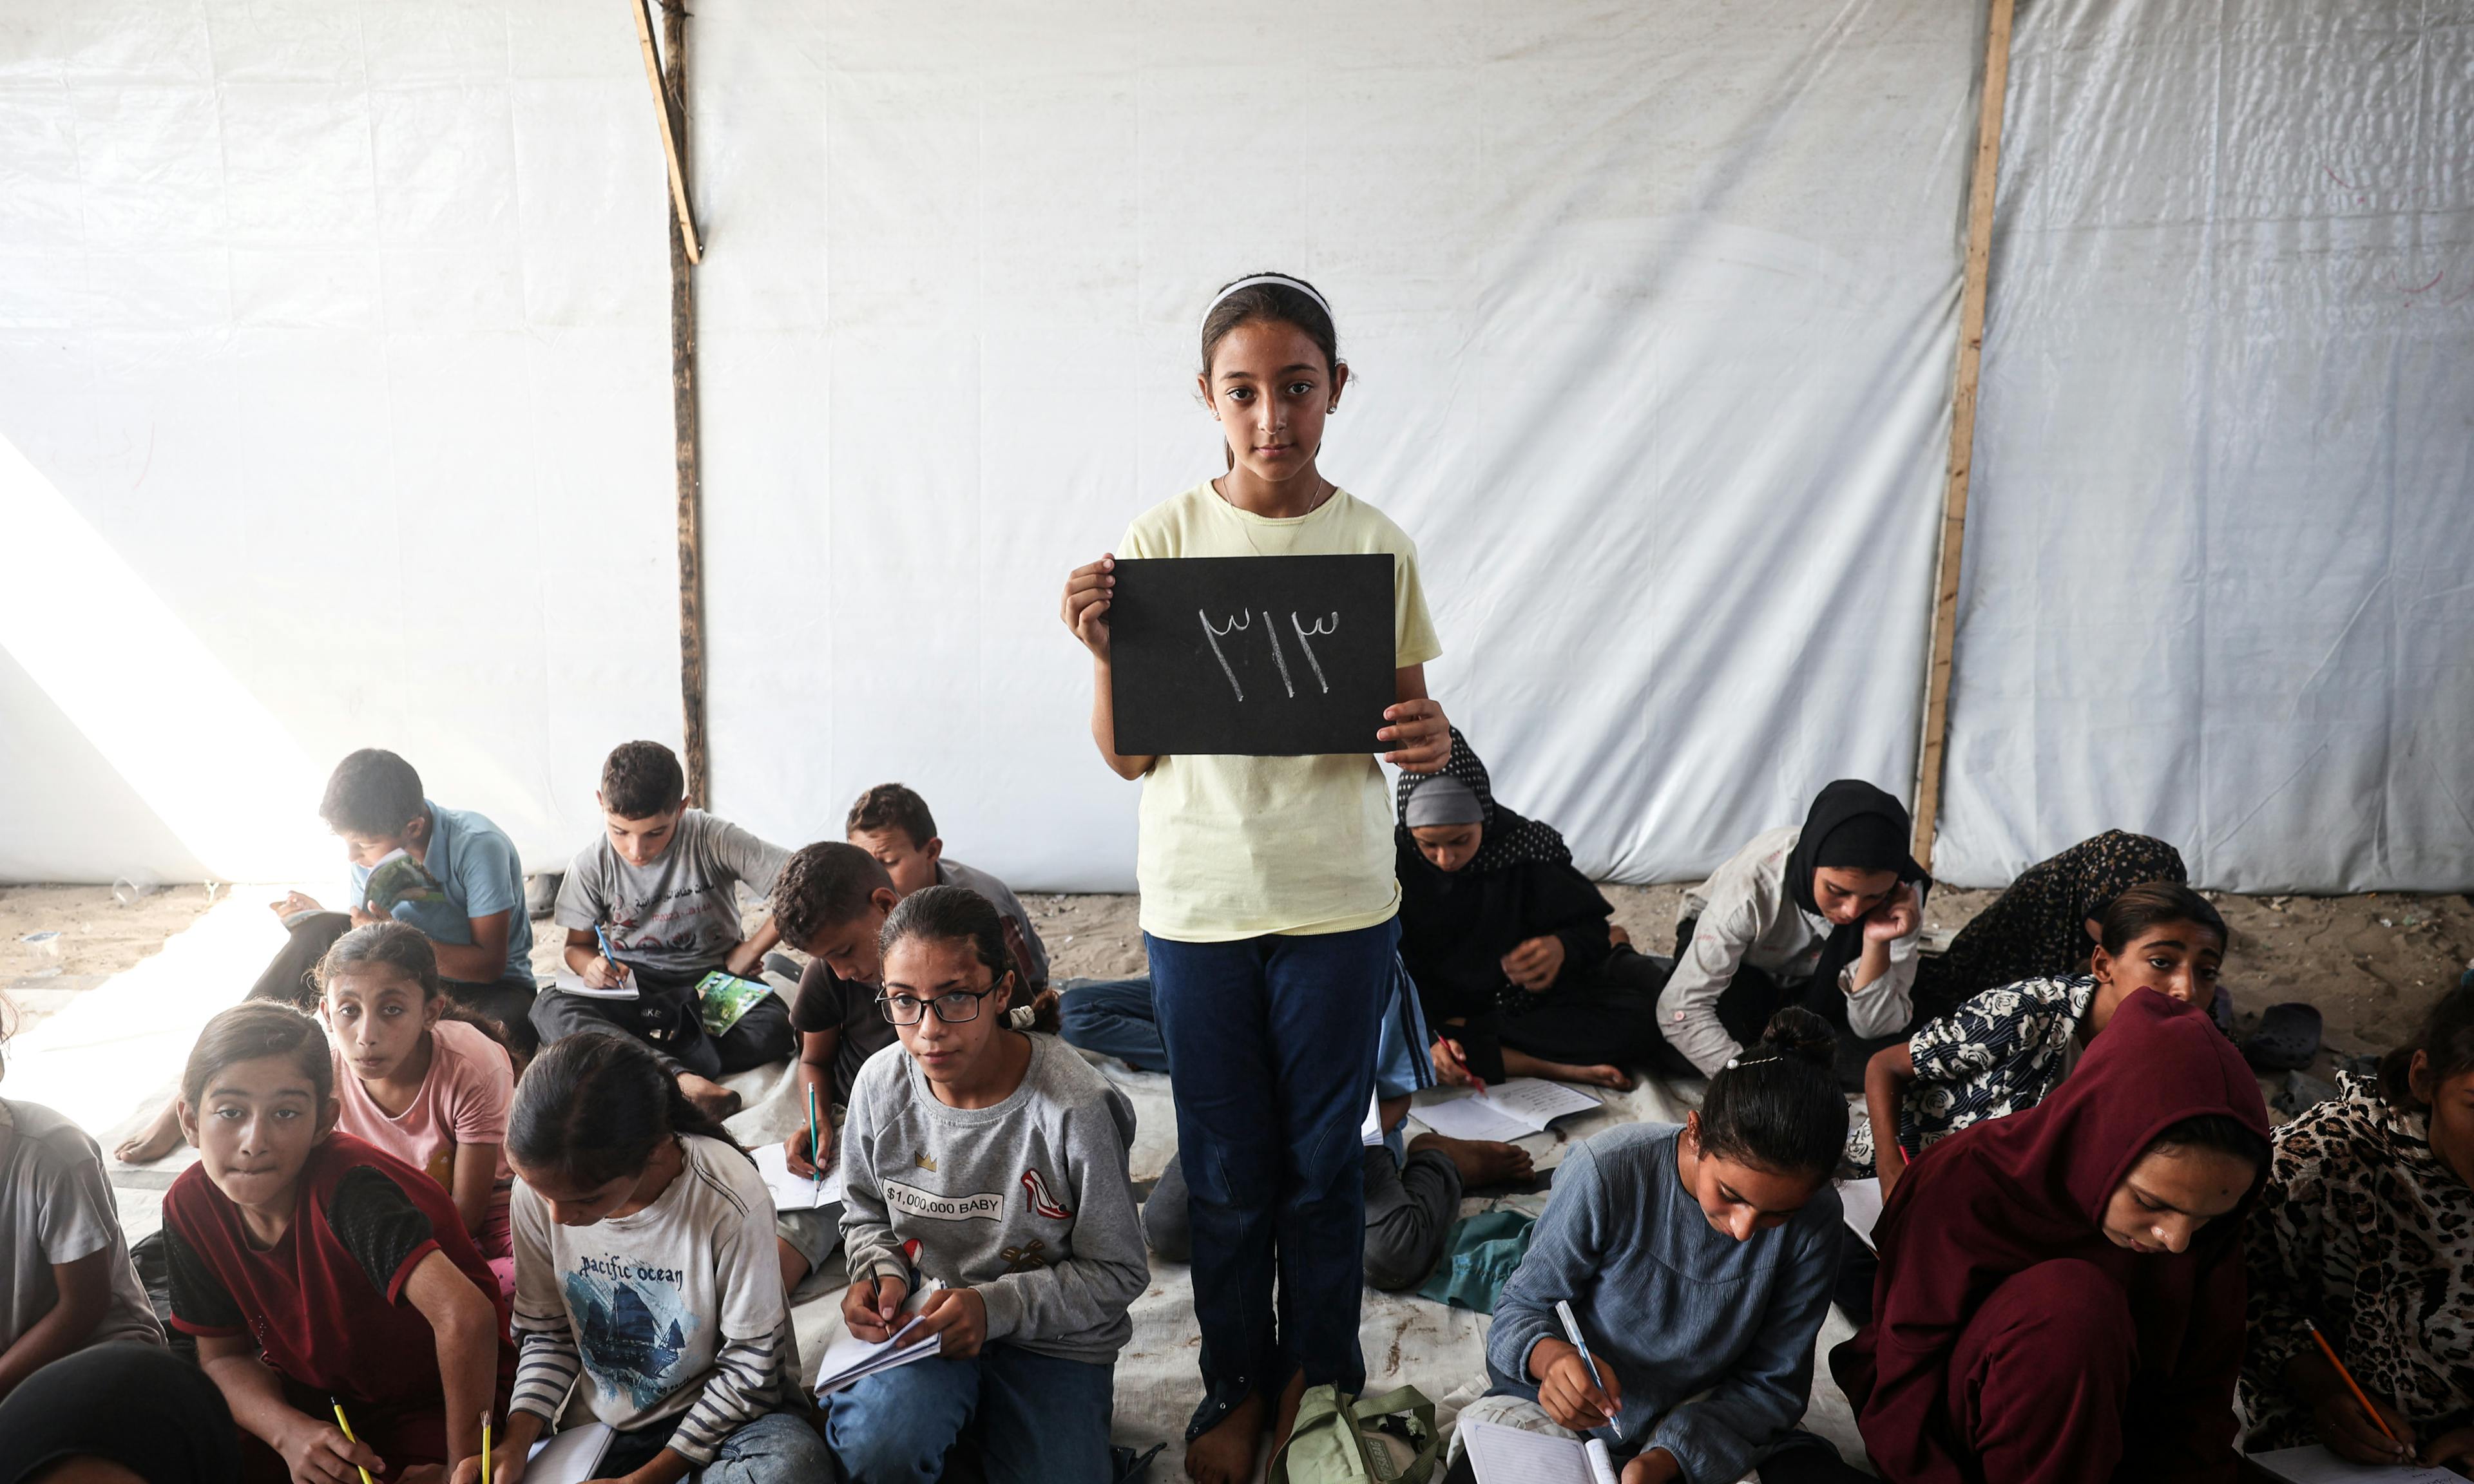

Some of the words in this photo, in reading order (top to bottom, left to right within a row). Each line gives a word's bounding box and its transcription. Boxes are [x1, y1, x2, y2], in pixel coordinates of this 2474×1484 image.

[1198, 606, 1340, 702] ٣١٣
[887, 1187, 955, 1214] $1,000,000
[959, 1199, 998, 1214] BABY
[579, 1252, 632, 1280] pacific
[637, 1268, 683, 1291] ocean
